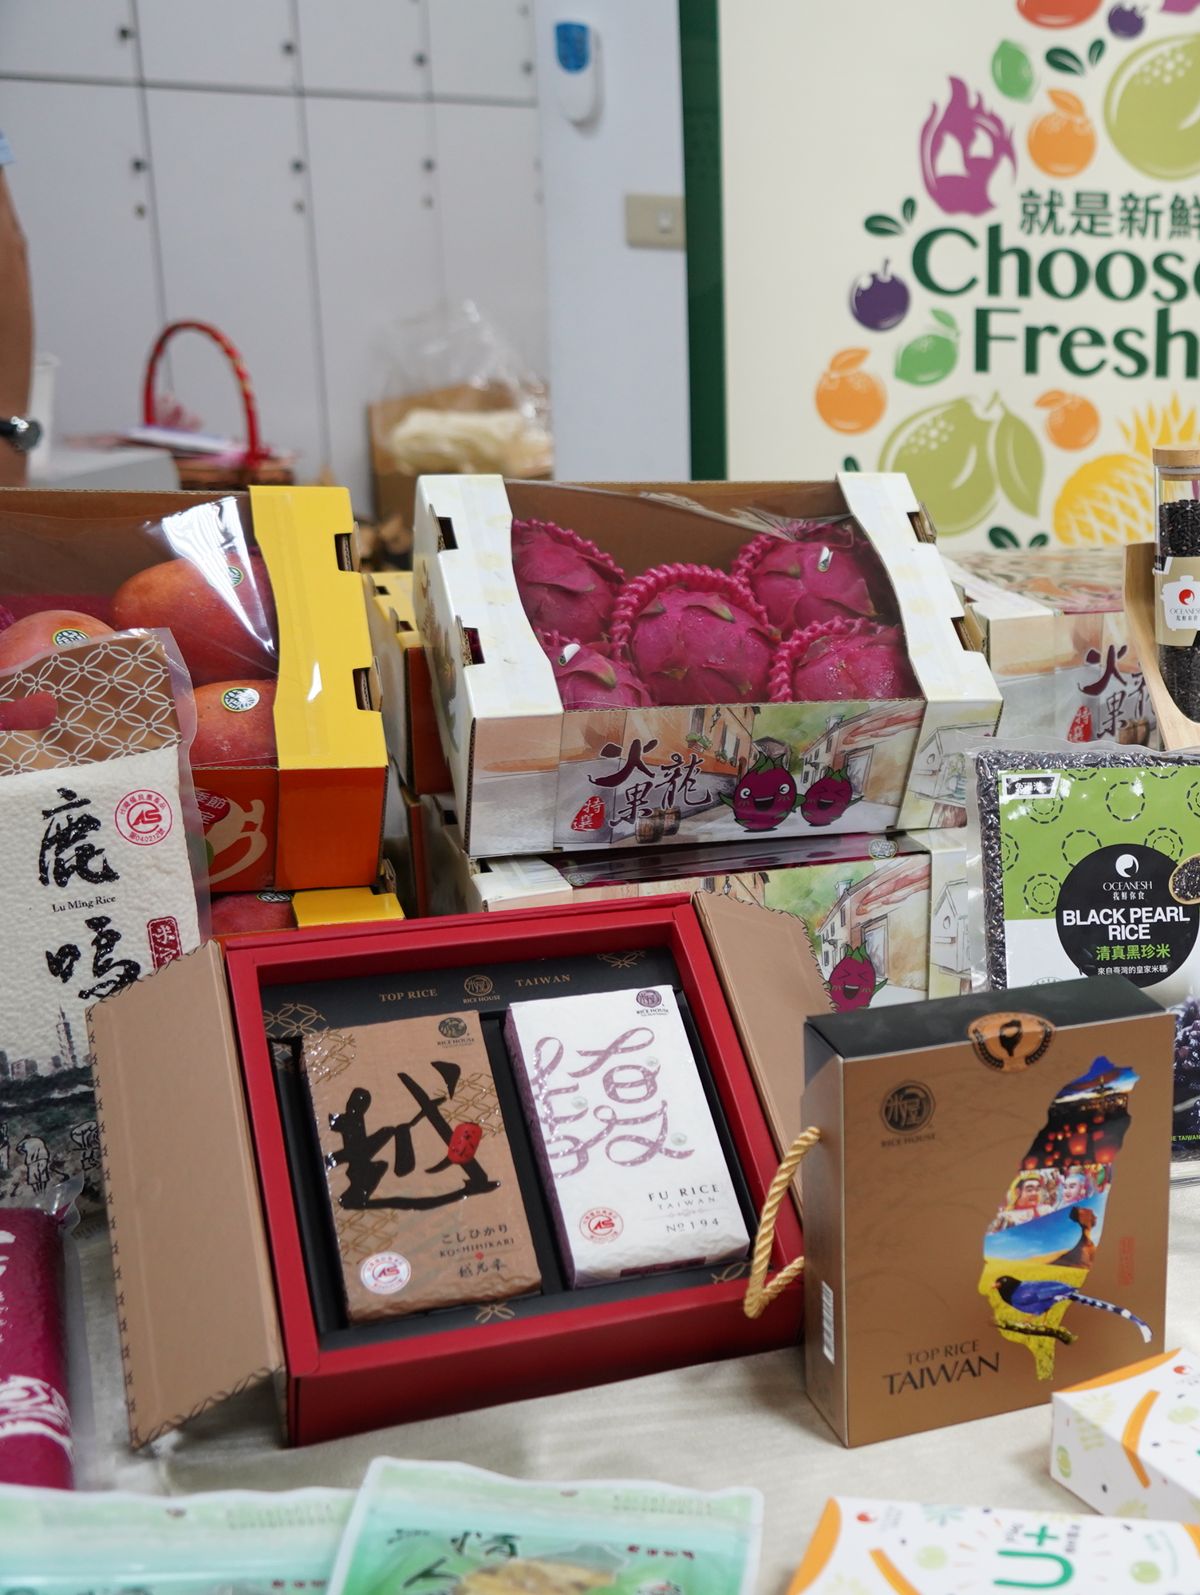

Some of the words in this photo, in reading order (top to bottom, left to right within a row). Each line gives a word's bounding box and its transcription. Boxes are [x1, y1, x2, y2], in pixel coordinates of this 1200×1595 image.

[1102, 881, 1153, 891] OCEANESH
[52, 902, 67, 913] Lu
[67, 898, 95, 913] Ming
[95, 893, 117, 907] Rice
[1062, 908, 1127, 926] BLACK
[1129, 906, 1191, 924] PEARL
[1108, 924, 1151, 941] RICE
[1096, 943, 1171, 961] 清真黑珍米
[515, 973, 573, 988] TAIWAN
[379, 992, 405, 1003] TOP
[407, 988, 438, 1000] RICE
[648, 1190, 669, 1202] FU
[679, 1184, 720, 1198] RICE
[441, 1224, 508, 1245] こしひかり
[907, 1346, 936, 1364] TOP
[939, 1339, 980, 1358] RICE
[882, 1352, 1000, 1397] TAIWAN
